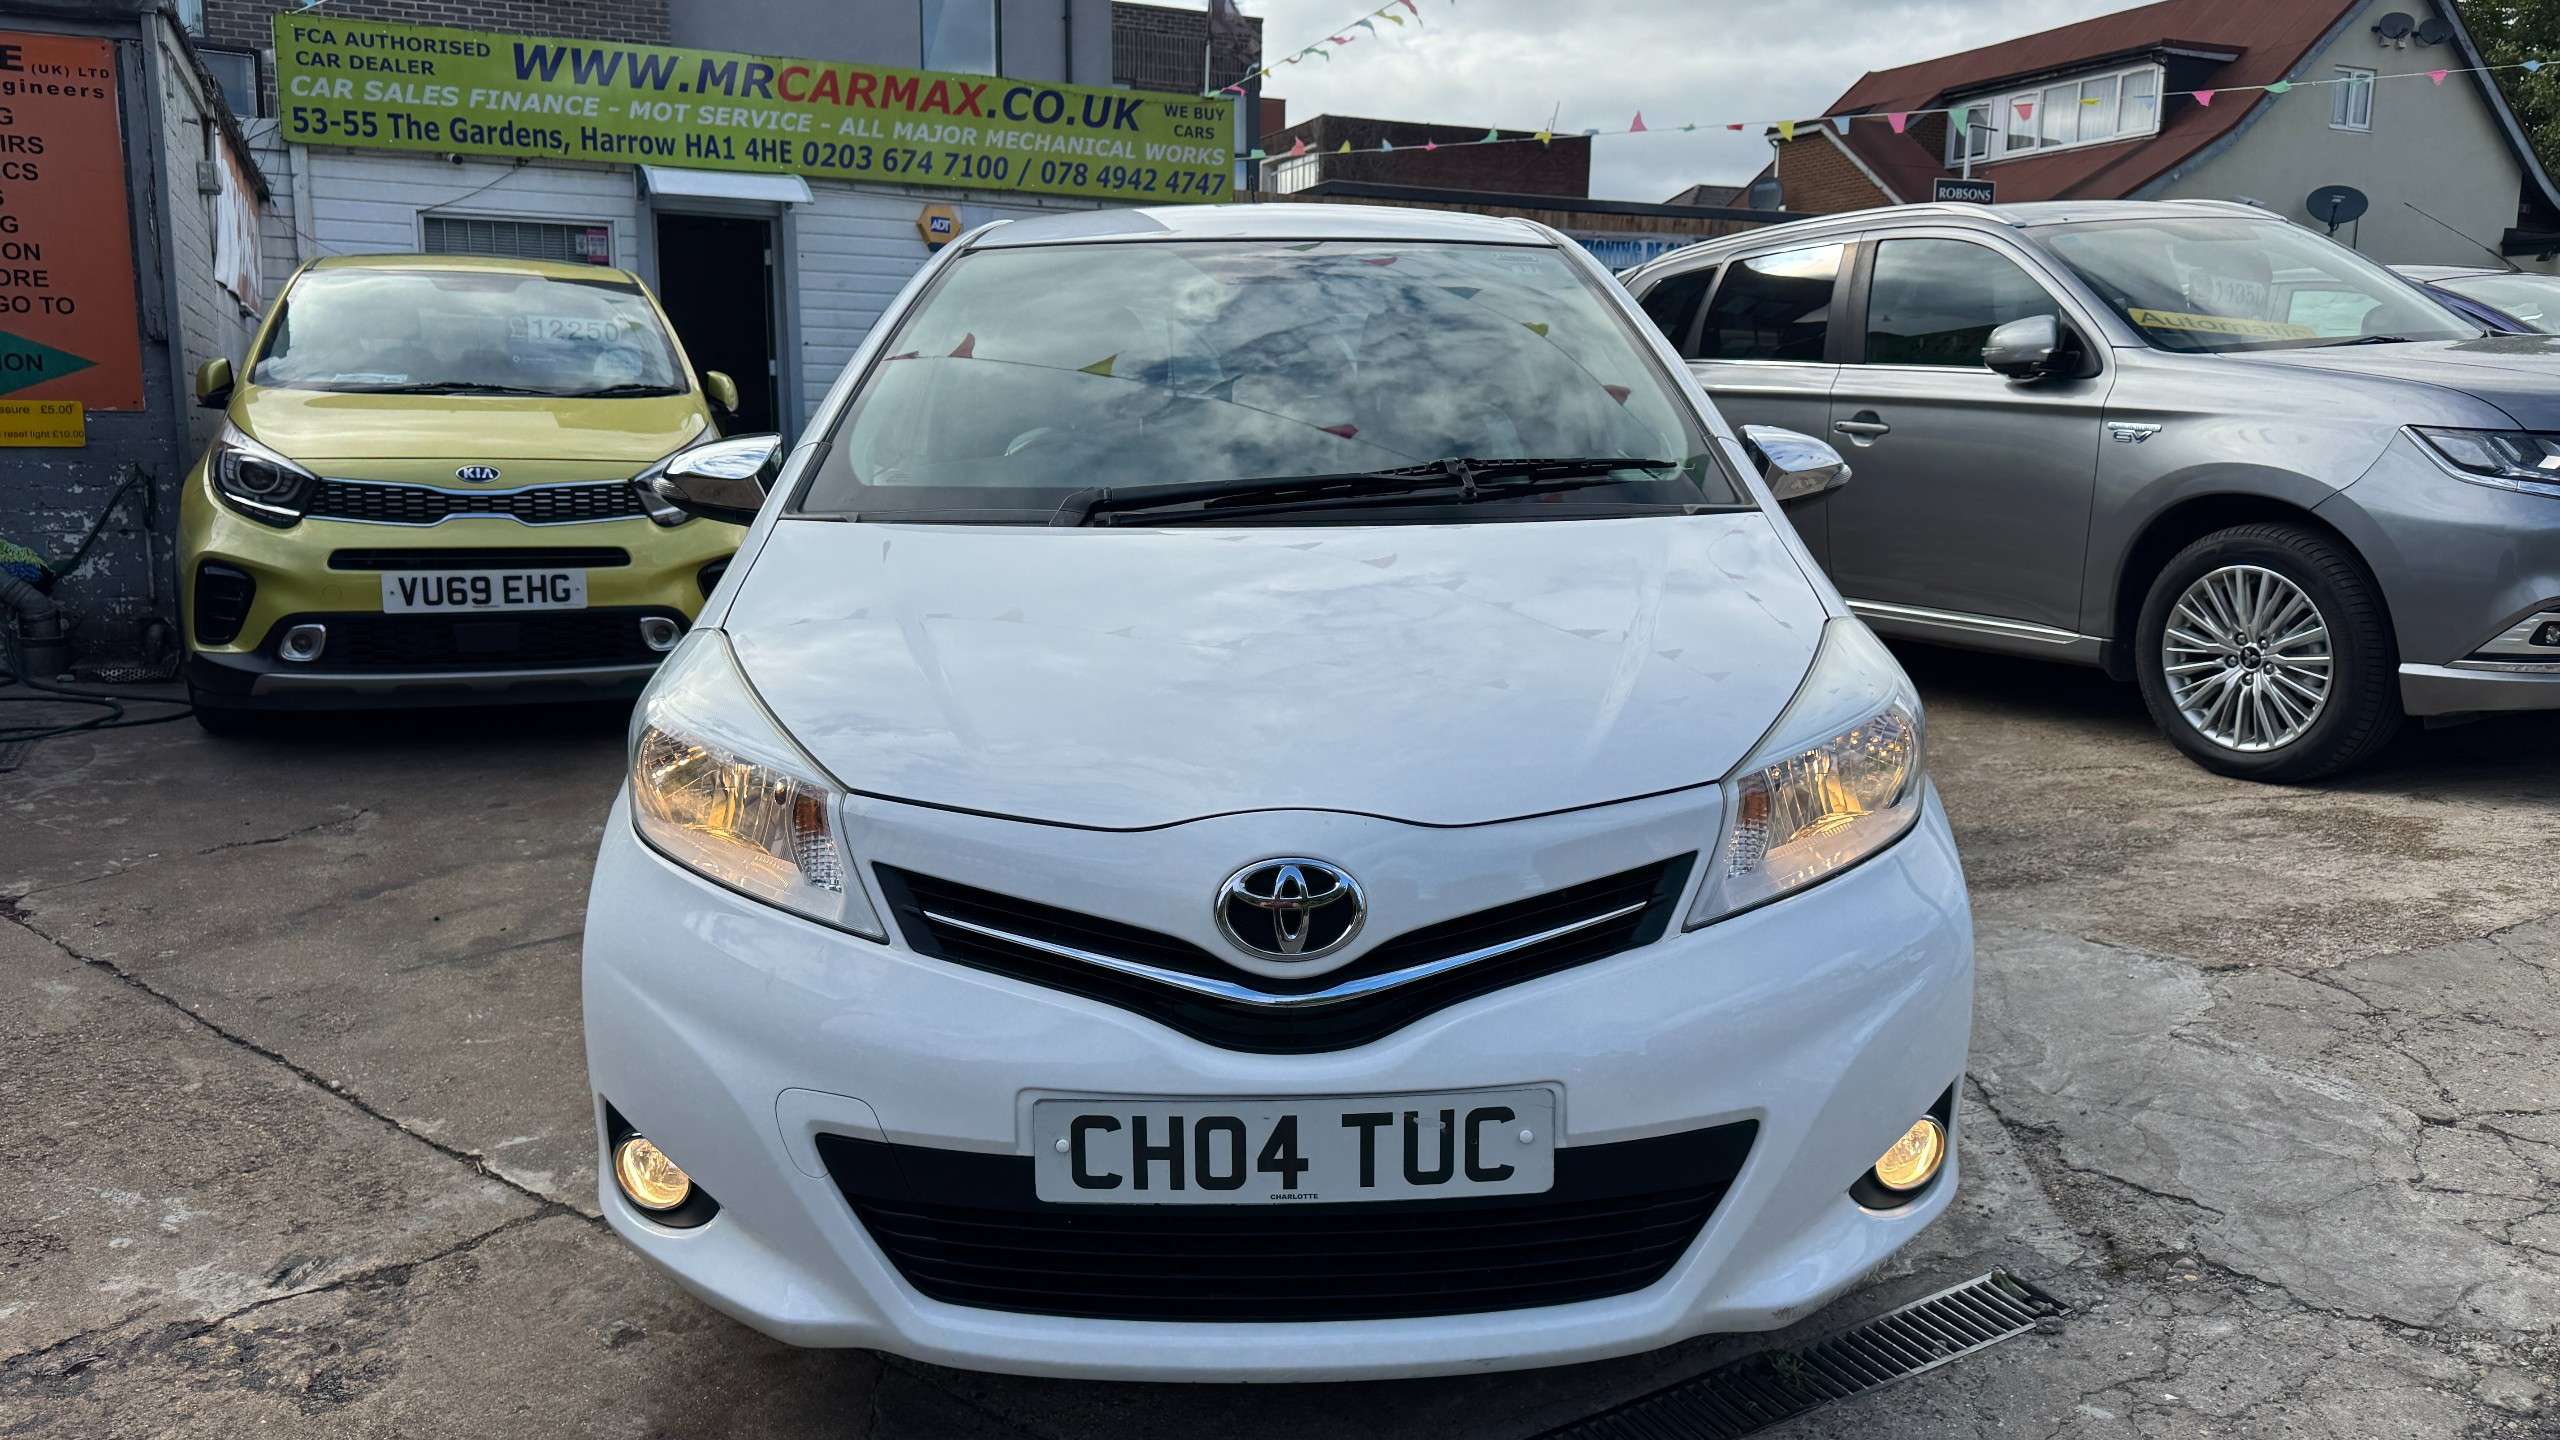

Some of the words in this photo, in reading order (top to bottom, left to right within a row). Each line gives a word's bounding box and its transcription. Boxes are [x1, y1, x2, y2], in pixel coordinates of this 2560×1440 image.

[293, 27, 337, 45] FCA
[345, 31, 491, 57] AUTHORISED
[31, 63, 70, 78] (UK)
[78, 67, 109, 79] LTD
[295, 51, 341, 68] CAR
[349, 55, 436, 76] DEALER
[2, 78, 105, 99] gineers
[513, 42, 1144, 132] WWW.MRCARMAX.CO.UK
[290, 75, 353, 99] CAR
[364, 80, 459, 106] SALES
[469, 88, 600, 116] FINANCE
[629, 100, 691, 123] MOT
[697, 105, 813, 132] SERVICE
[838, 117, 884, 139] ALL
[893, 121, 977, 146] MAJOR
[985, 129, 1137, 159] MECHANICAL
[1145, 142, 1225, 166] WORKS
[1164, 104, 1188, 118] WE
[1194, 107, 1225, 121] BUY
[1174, 125, 1215, 139] CARS
[292, 106, 378, 138] 53-55
[387, 112, 440, 142] The
[450, 116, 571, 155] Gardens,
[581, 126, 676, 156] Harrow
[686, 133, 735, 160] HA1
[745, 137, 793, 164] 4HE
[802, 141, 873, 171] 0203
[883, 147, 933, 175] 674
[943, 152, 1009, 180] 7100
[1017, 158, 1032, 186] /
[1041, 160, 1088, 186] 078
[1096, 165, 1157, 191] 4942
[1165, 170, 1226, 196] 4747
[2, 161, 39, 180] CS
[1939, 187, 1991, 201] ROBSONS
[931, 218, 949, 231] ADT
[2, 242, 41, 260] ON
[38, 296, 75, 314] TO
[2141, 311, 2314, 339] Automatic
[40, 404, 73, 415] £5.00
[463, 467, 494, 479] KIA
[398, 576, 492, 607] VU69
[503, 574, 571, 603] EHG
[1070, 1114, 1309, 1191] CH04
[1341, 1105, 1515, 1187] TUC
